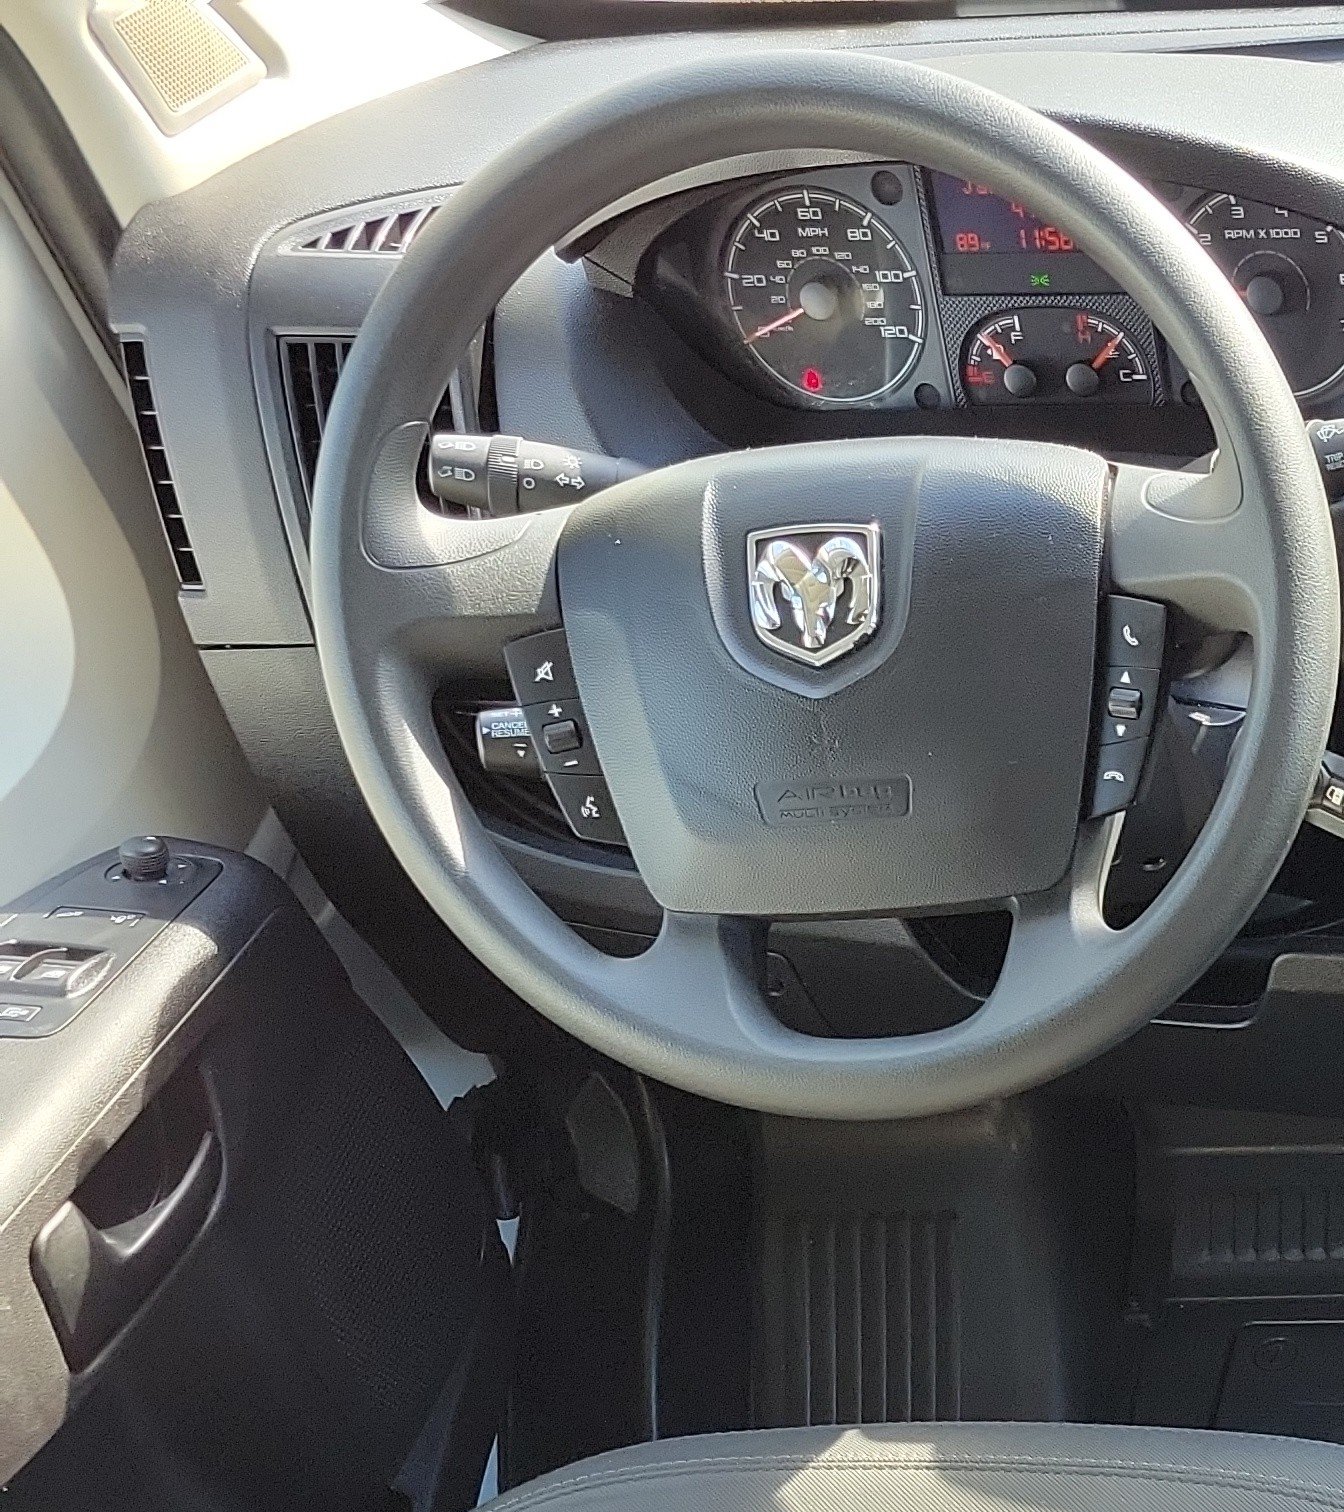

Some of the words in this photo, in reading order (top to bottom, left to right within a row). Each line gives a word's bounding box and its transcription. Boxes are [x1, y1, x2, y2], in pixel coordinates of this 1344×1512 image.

[797, 208, 822, 220] 60
[1231, 206, 1245, 219] 3
[754, 229, 780, 242] 40
[797, 227, 829, 237] MPH
[847, 228, 872, 241] 80
[1224, 229, 1255, 239] RPM
[1257, 229, 1267, 238] X
[1269, 228, 1300, 238] 1000
[1315, 232, 1328, 243] 5
[1200, 233, 1212, 245] 2
[791, 249, 807, 258] 80
[811, 246, 829, 255] 100
[834, 252, 852, 260] 120
[742, 274, 766, 286] 20
[875, 270, 903, 283] 100
[880, 326, 909, 339] 120
[1010, 331, 1024, 344] F
[1119, 369, 1133, 382] C
[491, 729, 532, 738] RESUME
